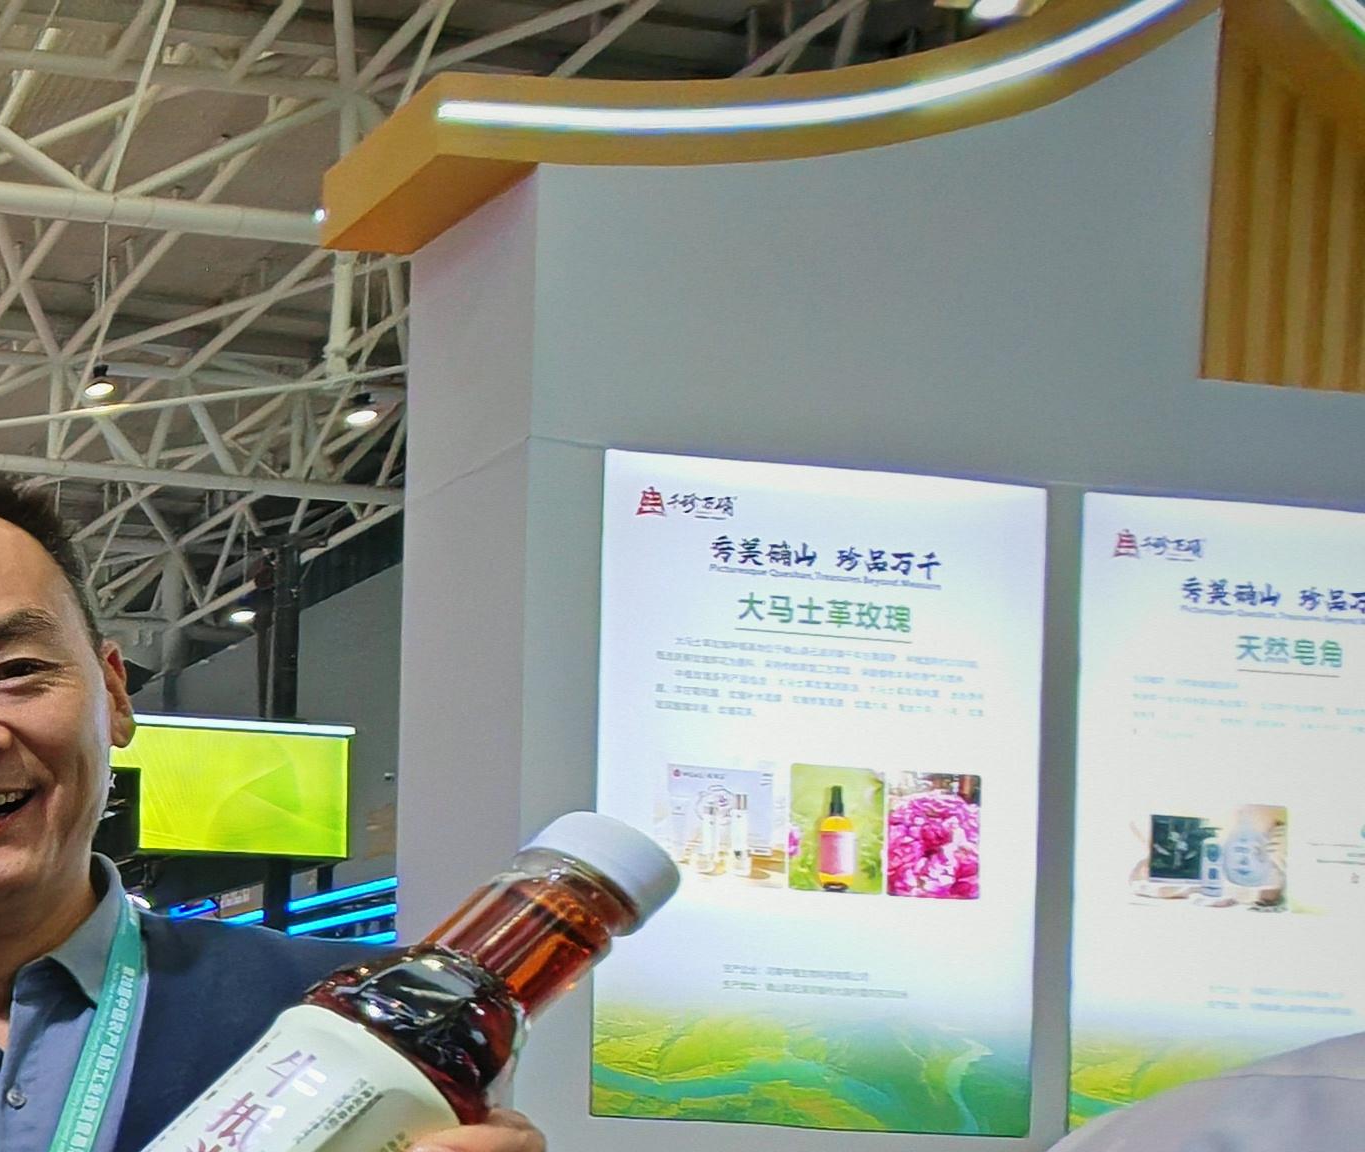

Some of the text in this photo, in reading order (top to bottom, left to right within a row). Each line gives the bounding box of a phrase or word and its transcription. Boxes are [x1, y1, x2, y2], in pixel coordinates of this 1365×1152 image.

[710, 535, 942, 580] 秀美确山 珍品万千
[1181, 576, 1281, 607] 秀美确山
[737, 592, 912, 633] 大马士革玫瑰
[1236, 634, 1343, 668] 天然皂角
